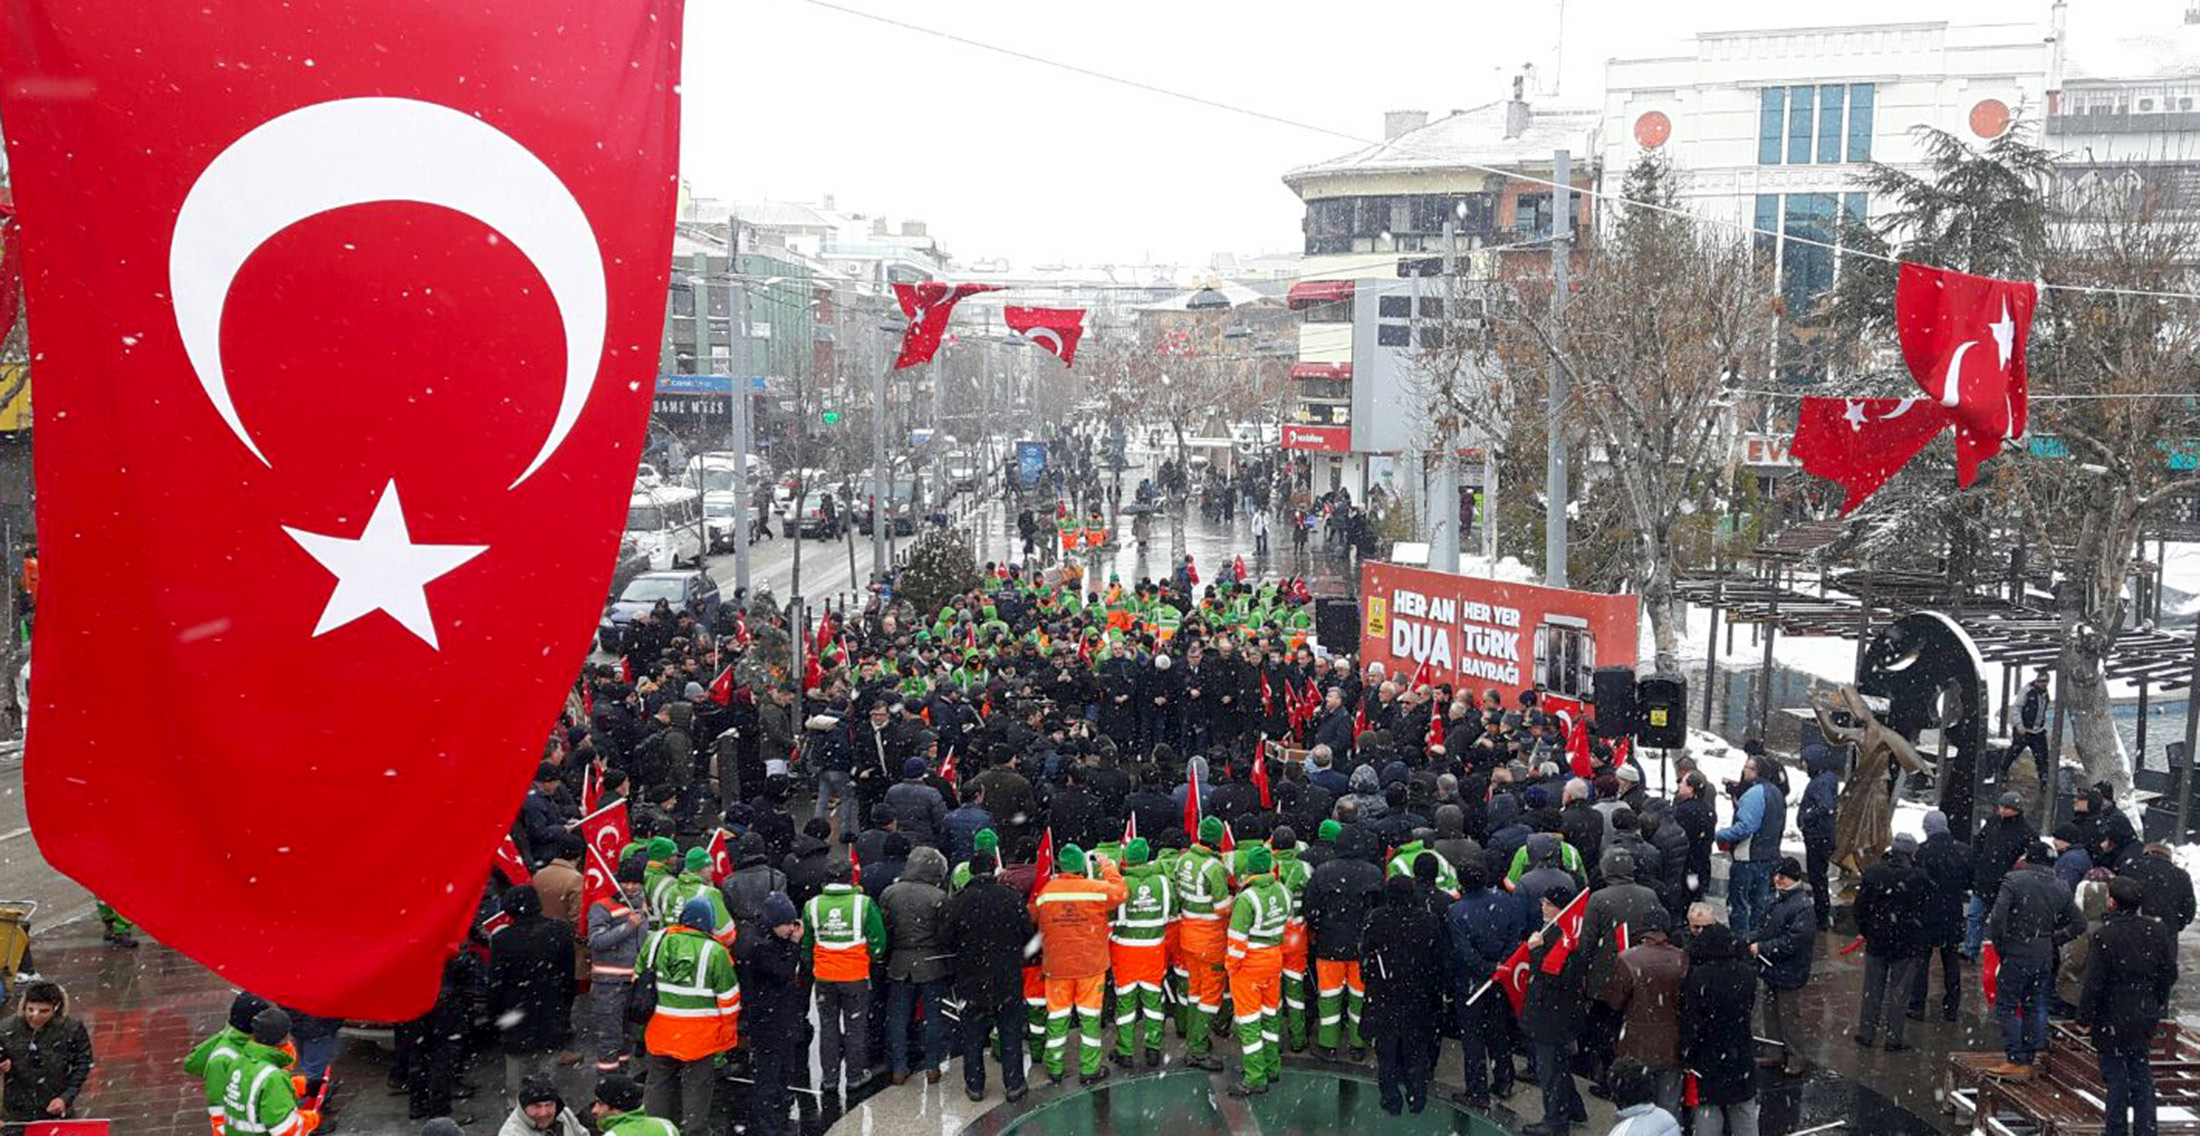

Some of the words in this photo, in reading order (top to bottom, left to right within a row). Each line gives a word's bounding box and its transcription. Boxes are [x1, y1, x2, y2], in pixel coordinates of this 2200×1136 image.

[1393, 589, 1427, 618] HER
[1429, 597, 1456, 624] AN
[1463, 601, 1491, 623] HER
[1493, 605, 1521, 628] YER
[1391, 618, 1453, 670] DUA
[1463, 623, 1520, 662] TÜRK
[1461, 656, 1520, 686] BAYRAĞI
